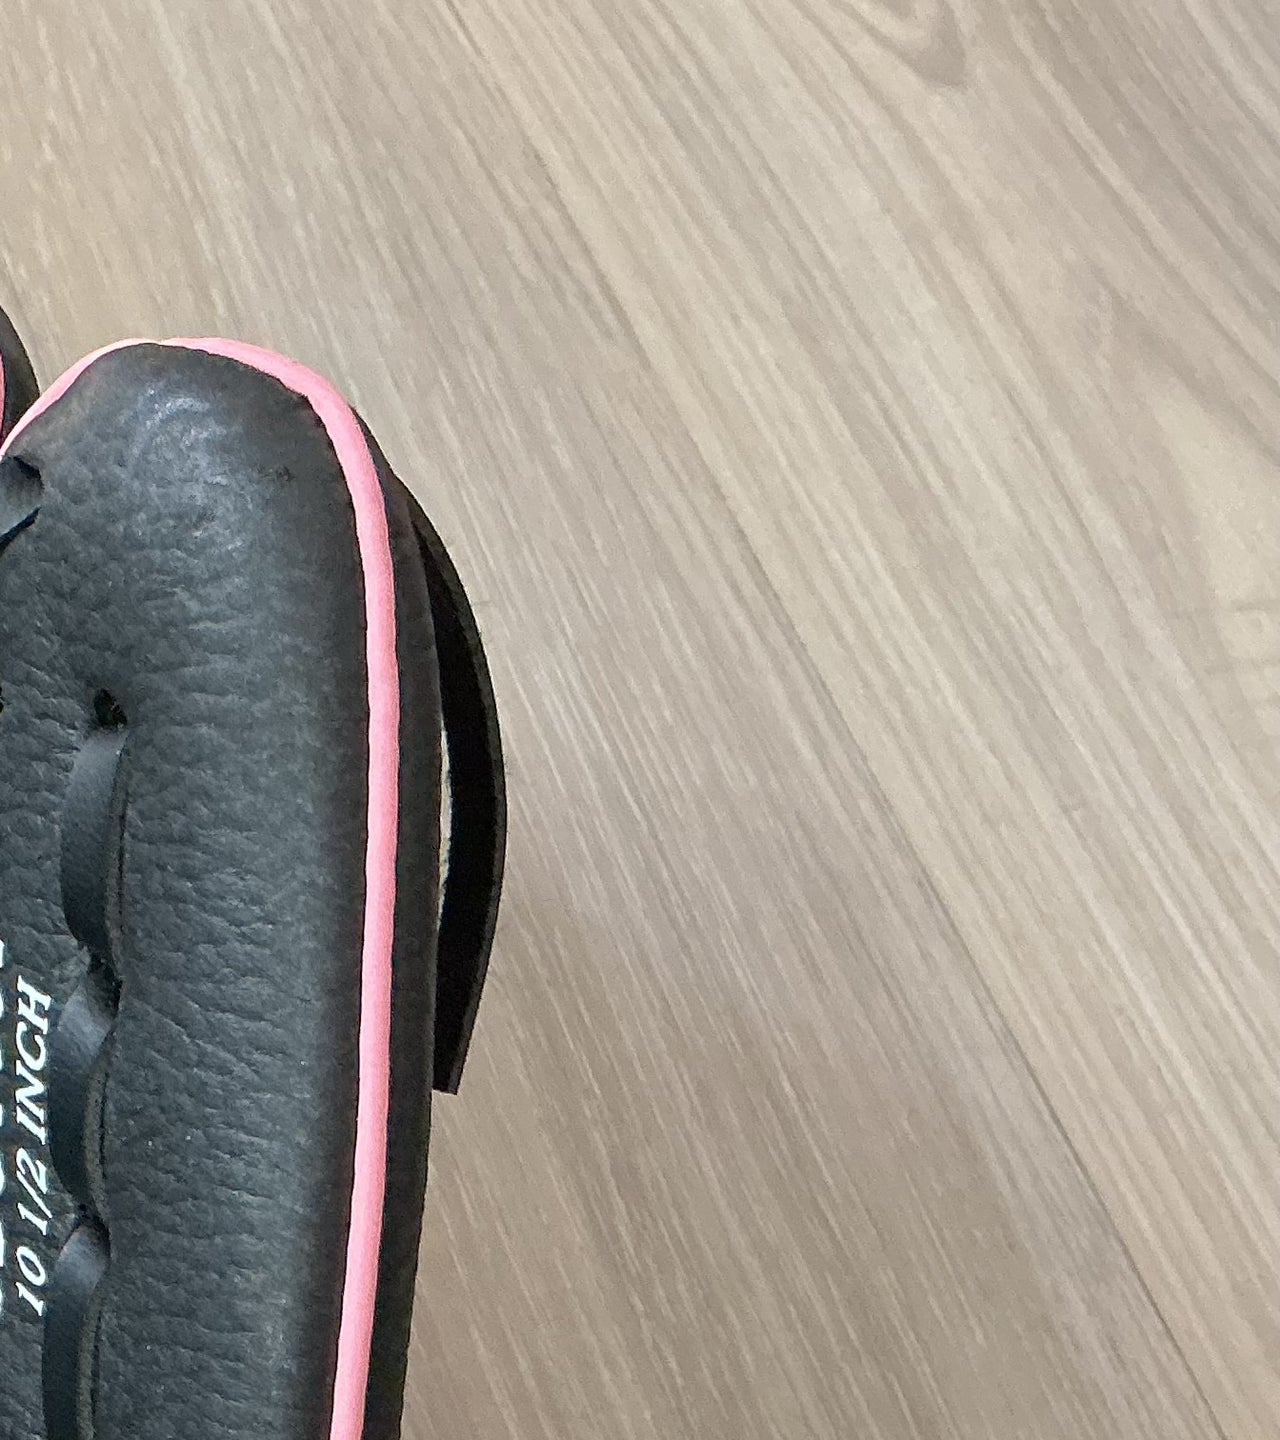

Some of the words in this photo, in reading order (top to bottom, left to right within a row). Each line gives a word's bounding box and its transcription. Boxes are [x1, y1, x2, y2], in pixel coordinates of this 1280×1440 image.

[16, 975, 53, 1146] INCH
[16, 1146, 53, 1236] 1/2
[15, 1249, 45, 1317] 10
